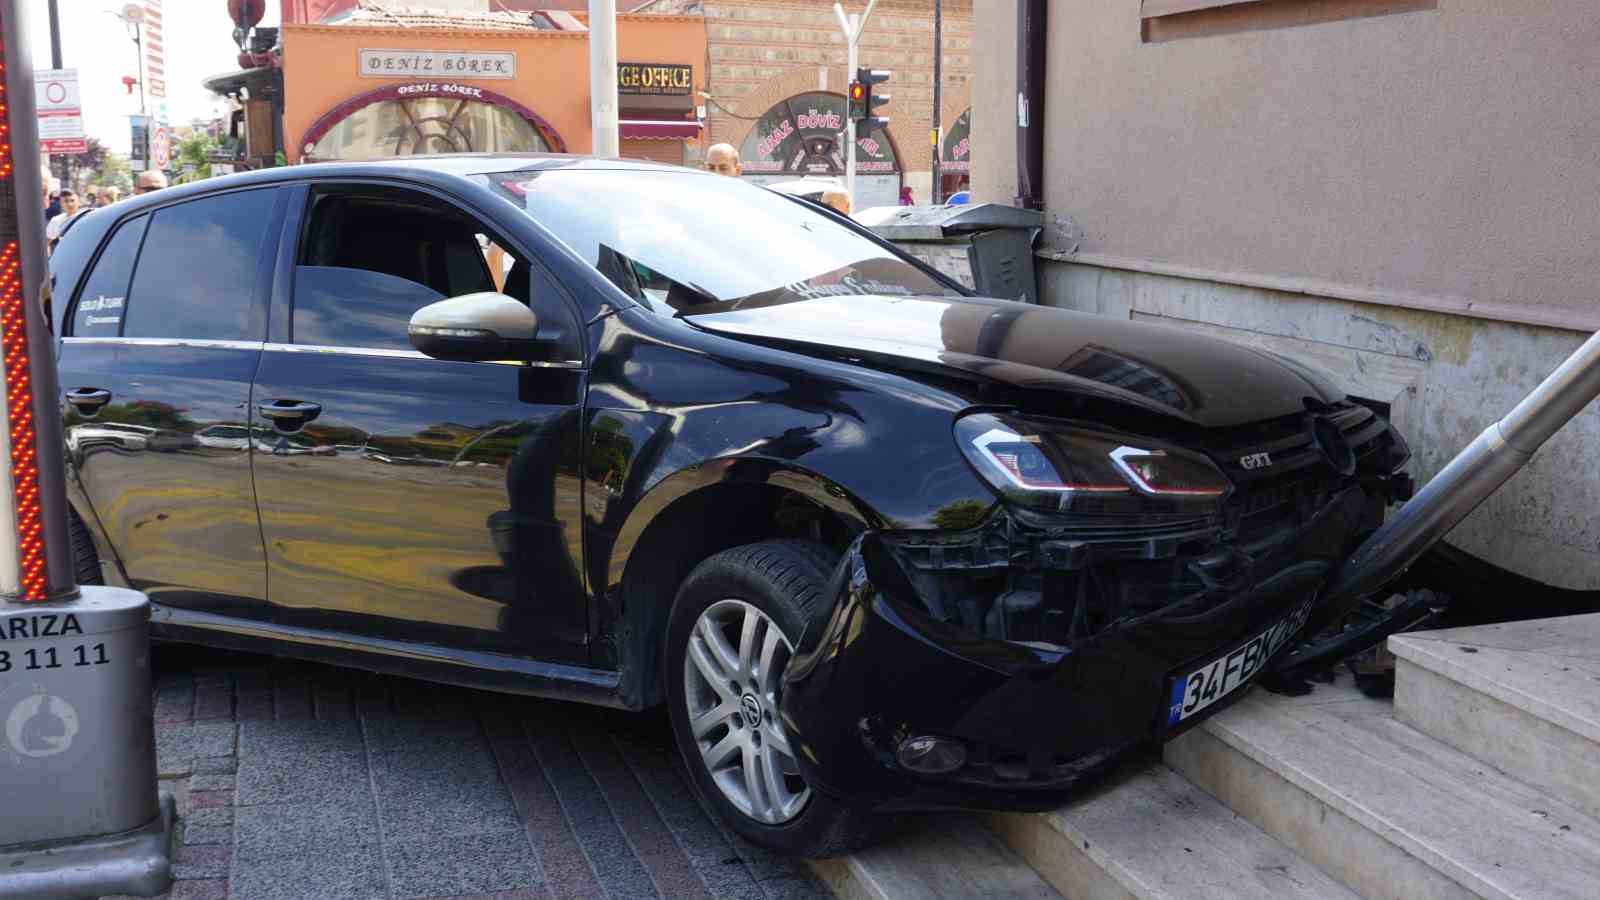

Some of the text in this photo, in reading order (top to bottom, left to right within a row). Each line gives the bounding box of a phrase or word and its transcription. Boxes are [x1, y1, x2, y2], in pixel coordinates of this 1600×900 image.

[368, 56, 507, 73] DENİZ BÖREK
[619, 66, 691, 88] GE OFFICE
[398, 82, 482, 97] DENİZ BÖREK
[797, 109, 842, 129] DÖVİZ
[1240, 452, 1272, 470] GTI
[24, 647, 62, 670] 11
[73, 643, 110, 667] 11
